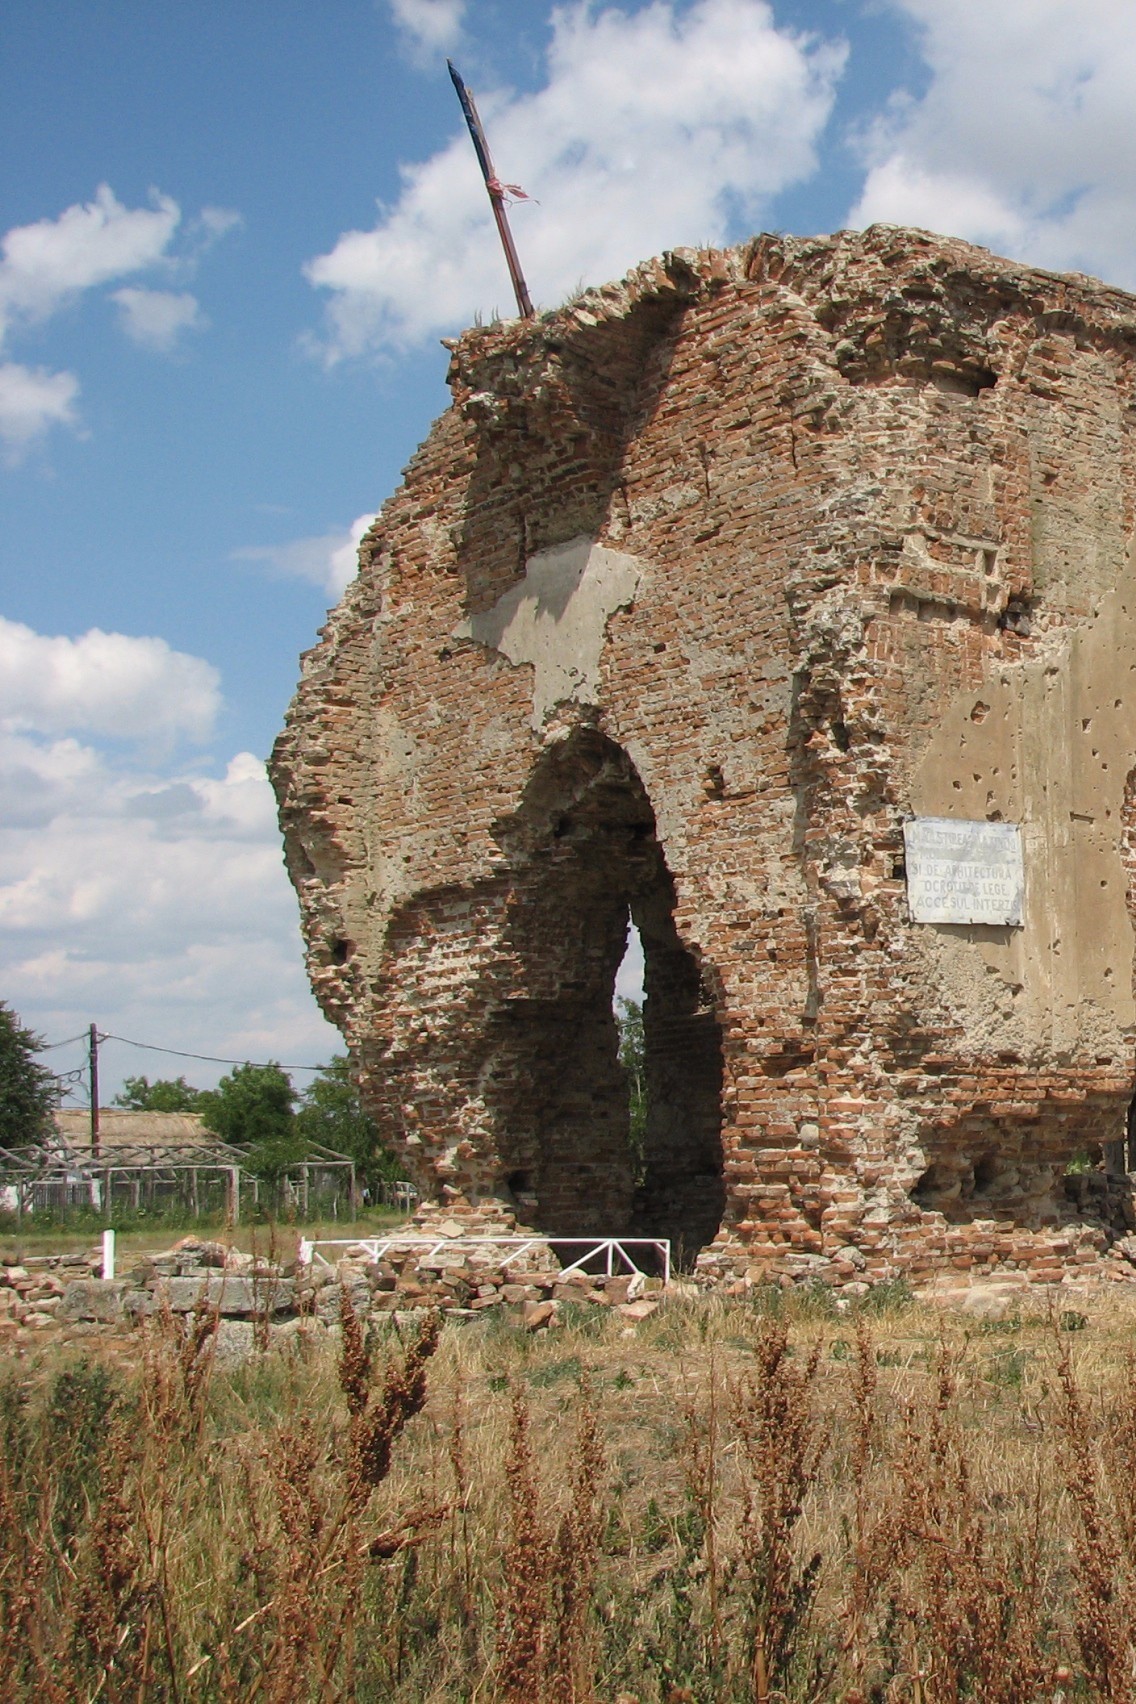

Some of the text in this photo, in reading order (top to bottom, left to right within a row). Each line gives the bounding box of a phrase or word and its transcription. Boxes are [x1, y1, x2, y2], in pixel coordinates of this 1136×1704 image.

[927, 864, 939, 876] DE
[916, 896, 1018, 912] ACCESUL INTERZIS
